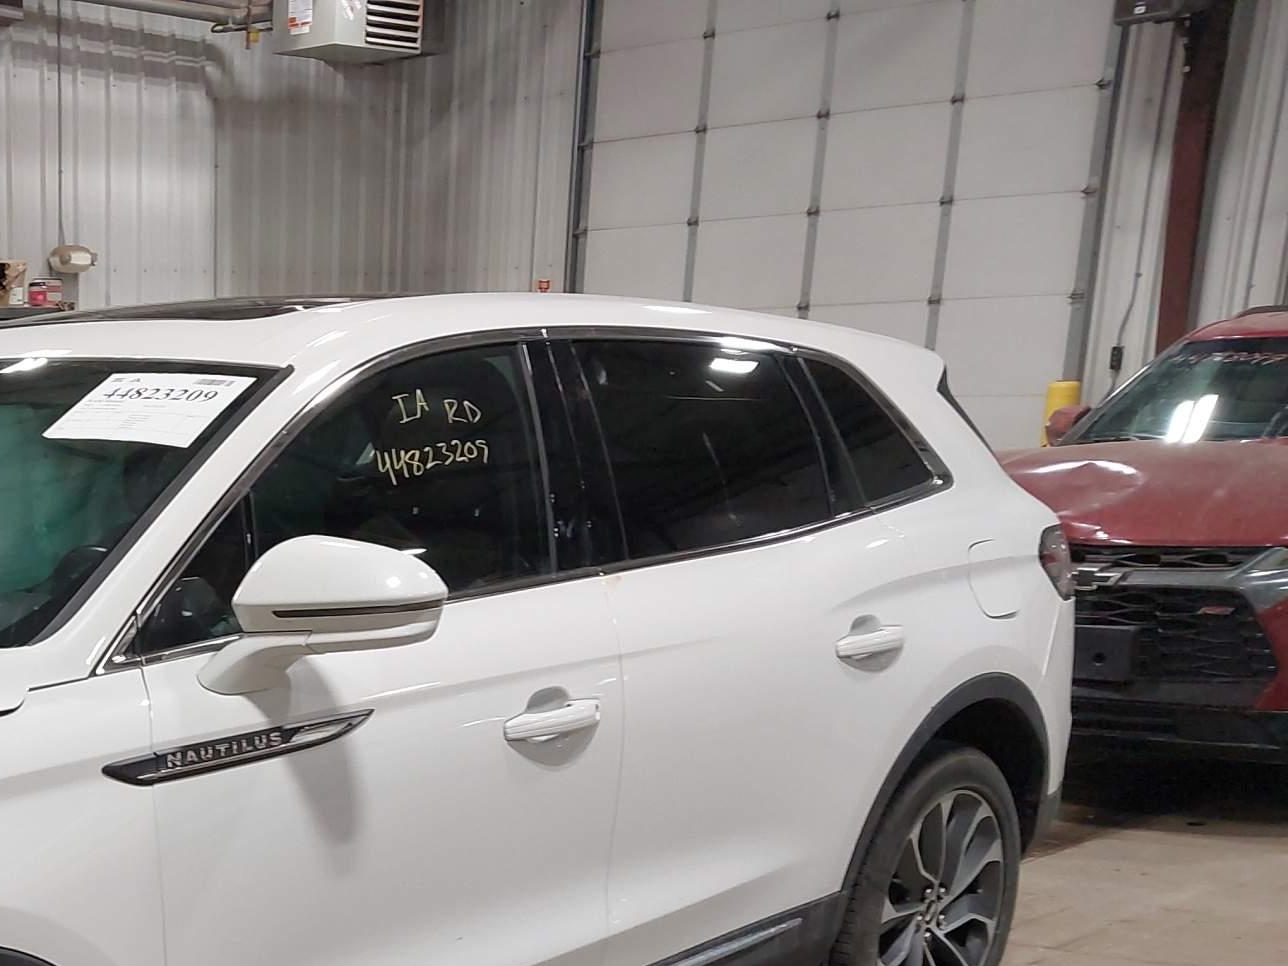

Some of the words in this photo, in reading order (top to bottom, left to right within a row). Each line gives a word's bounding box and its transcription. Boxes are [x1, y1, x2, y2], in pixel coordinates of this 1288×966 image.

[103, 387, 218, 403] 44823209
[392, 388, 430, 424] IA
[443, 399, 482, 424] RD
[375, 439, 489, 486] 44823209
[166, 732, 283, 768] NAUTILUS
